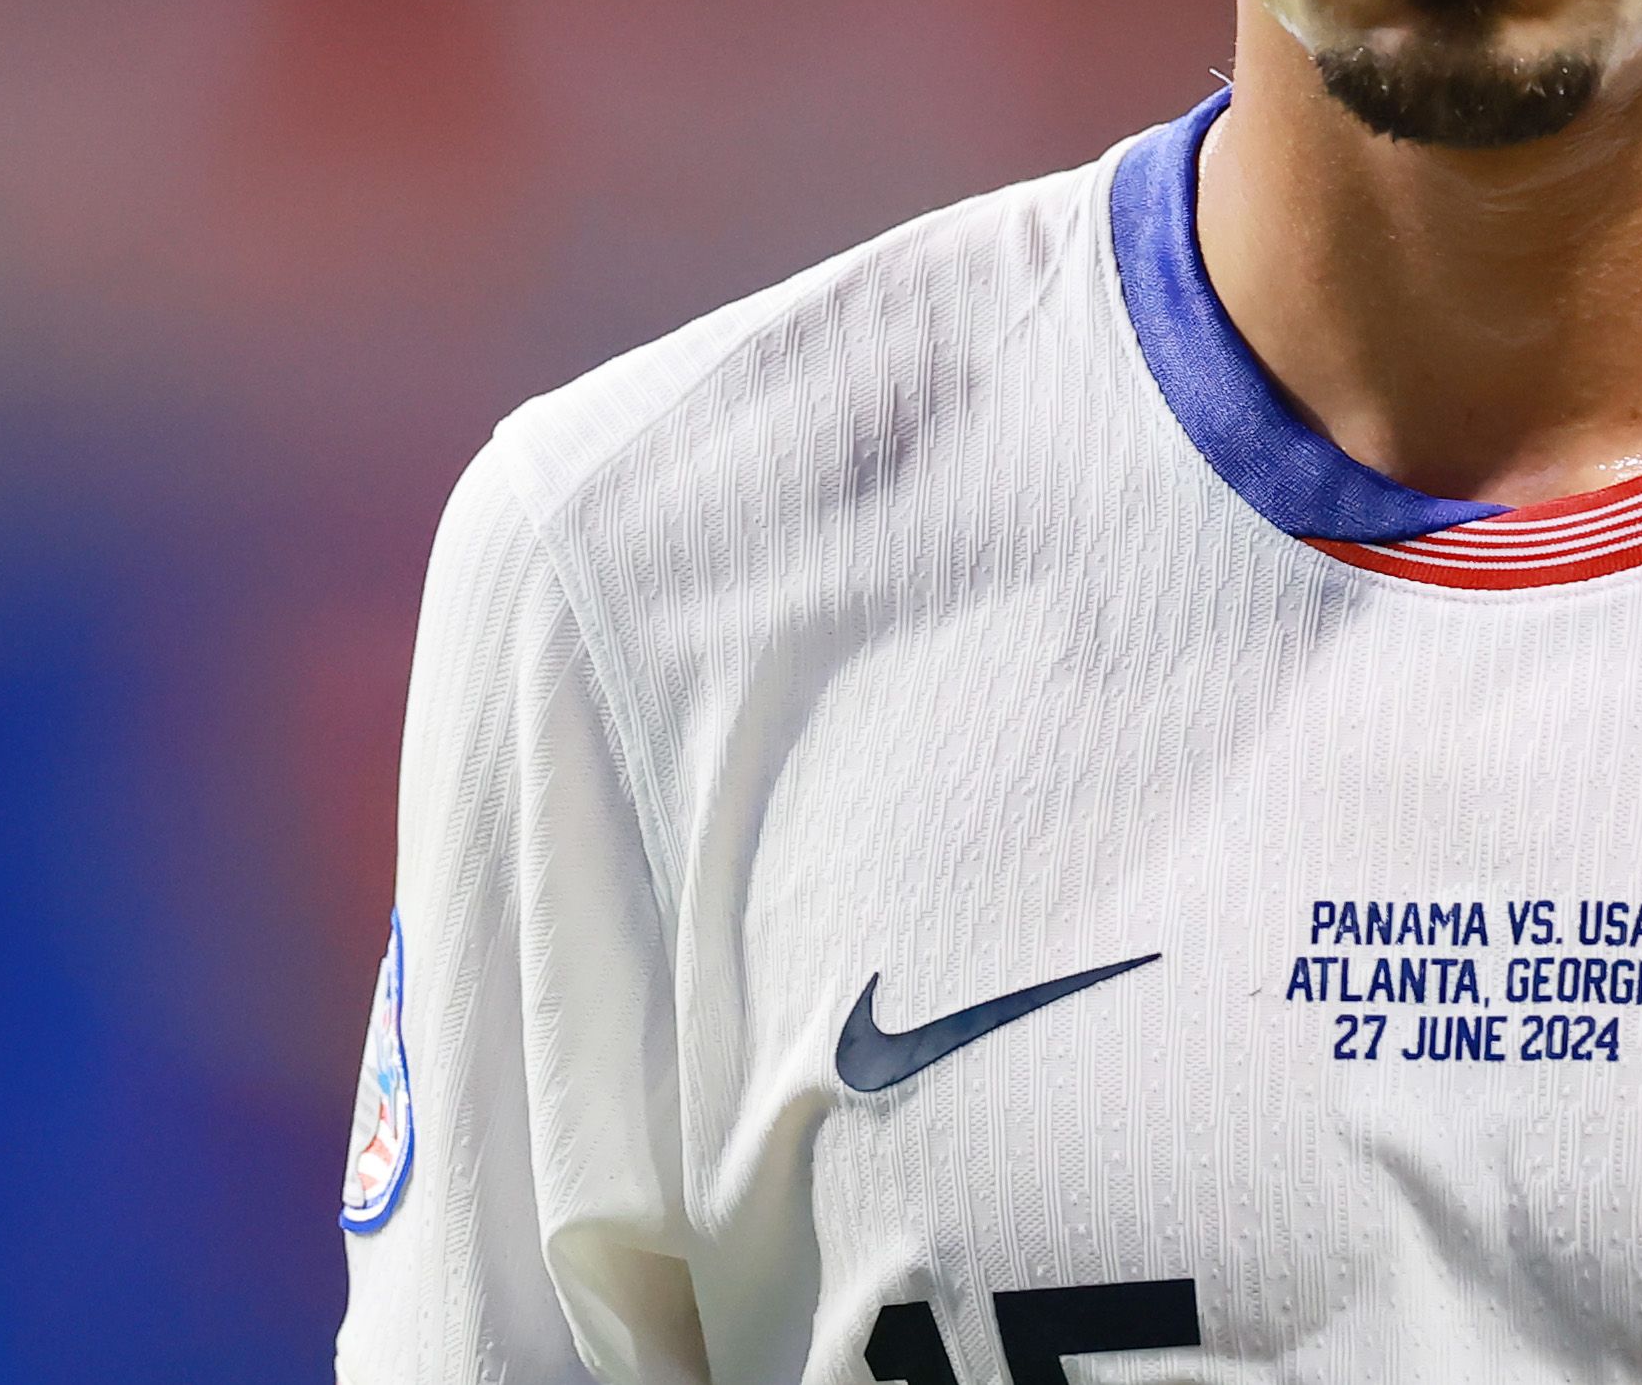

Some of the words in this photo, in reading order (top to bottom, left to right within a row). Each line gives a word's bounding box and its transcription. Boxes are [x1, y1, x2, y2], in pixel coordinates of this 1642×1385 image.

[1311, 900, 1489, 947] PANAMA
[1508, 900, 1563, 947] VS.
[1286, 956, 1490, 1008] ATLANTA,
[1333, 1014, 1387, 1062] 27
[1401, 1015, 1508, 1062] JUNE
[1520, 1014, 1620, 1062] 2024
